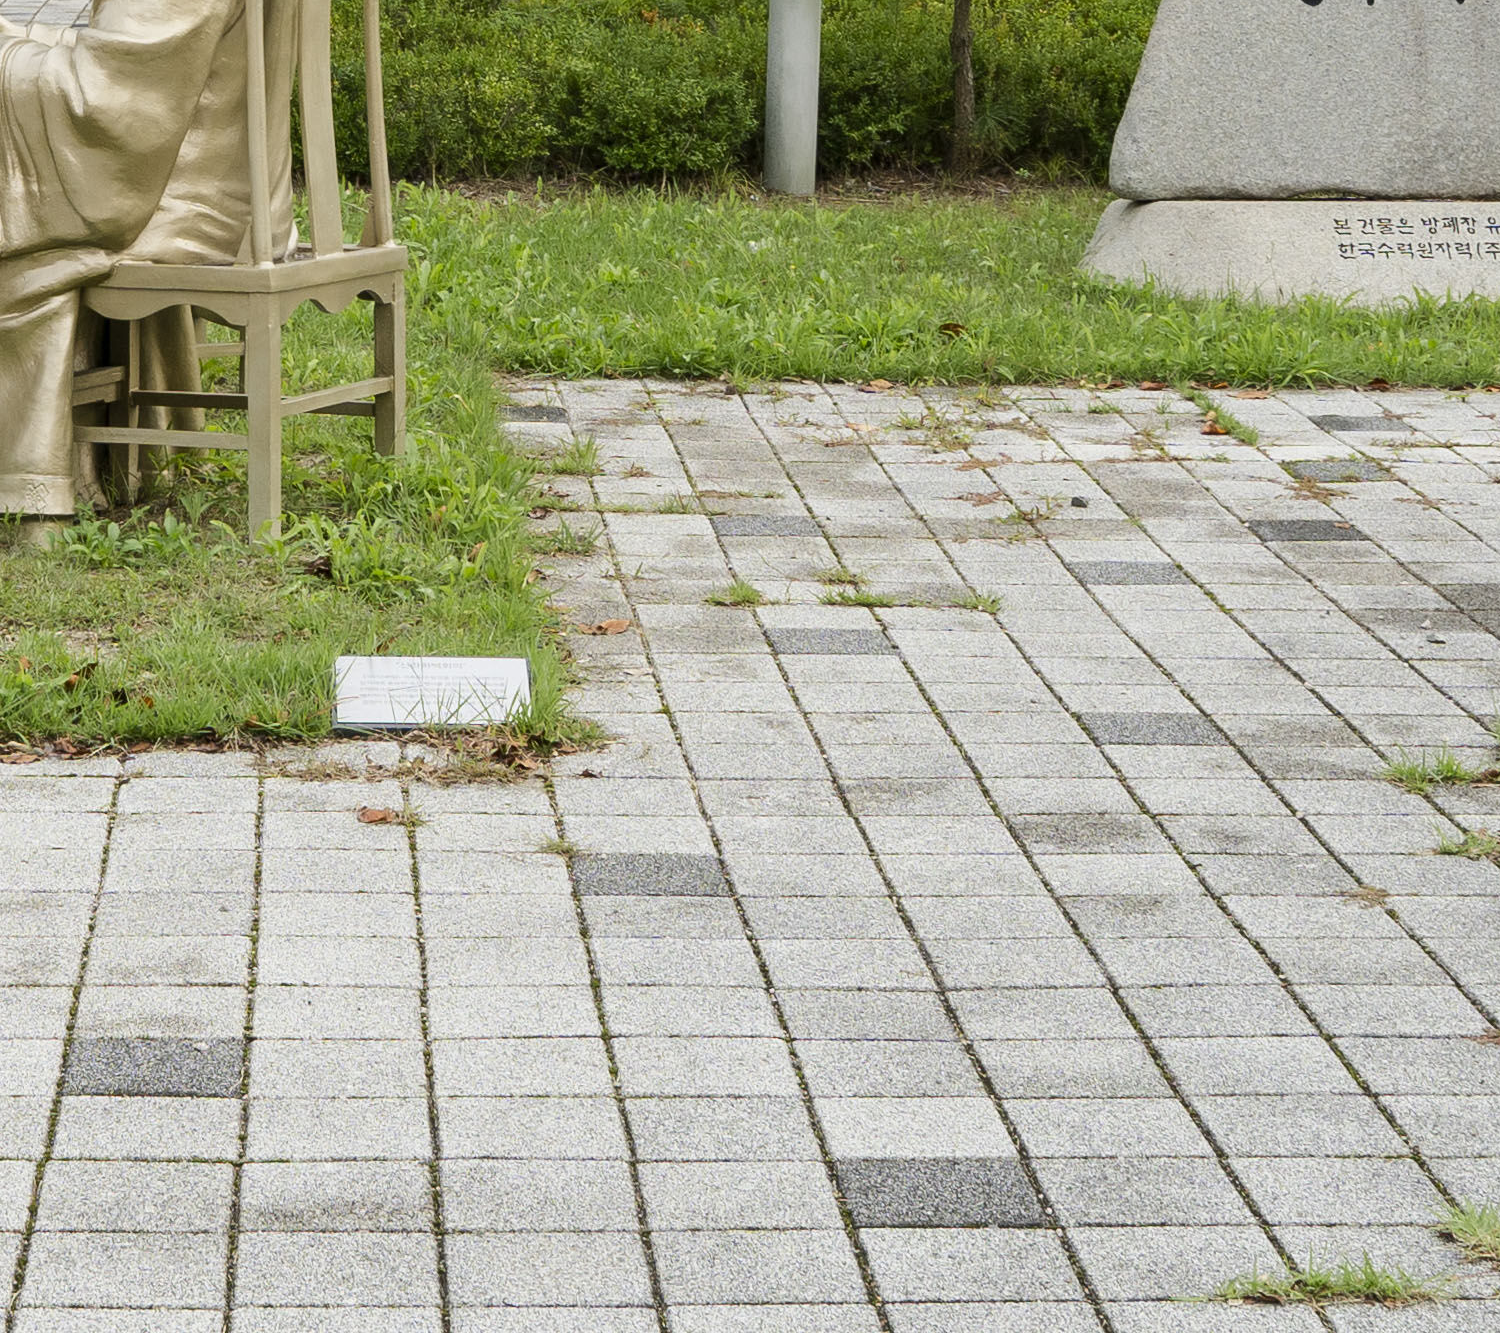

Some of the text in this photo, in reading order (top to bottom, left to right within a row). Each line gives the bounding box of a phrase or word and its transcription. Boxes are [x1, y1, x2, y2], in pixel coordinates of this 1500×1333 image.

[1333, 218, 1350, 235] 본
[1356, 217, 1415, 235] 건물은
[1420, 216, 1477, 235] 방폐장
